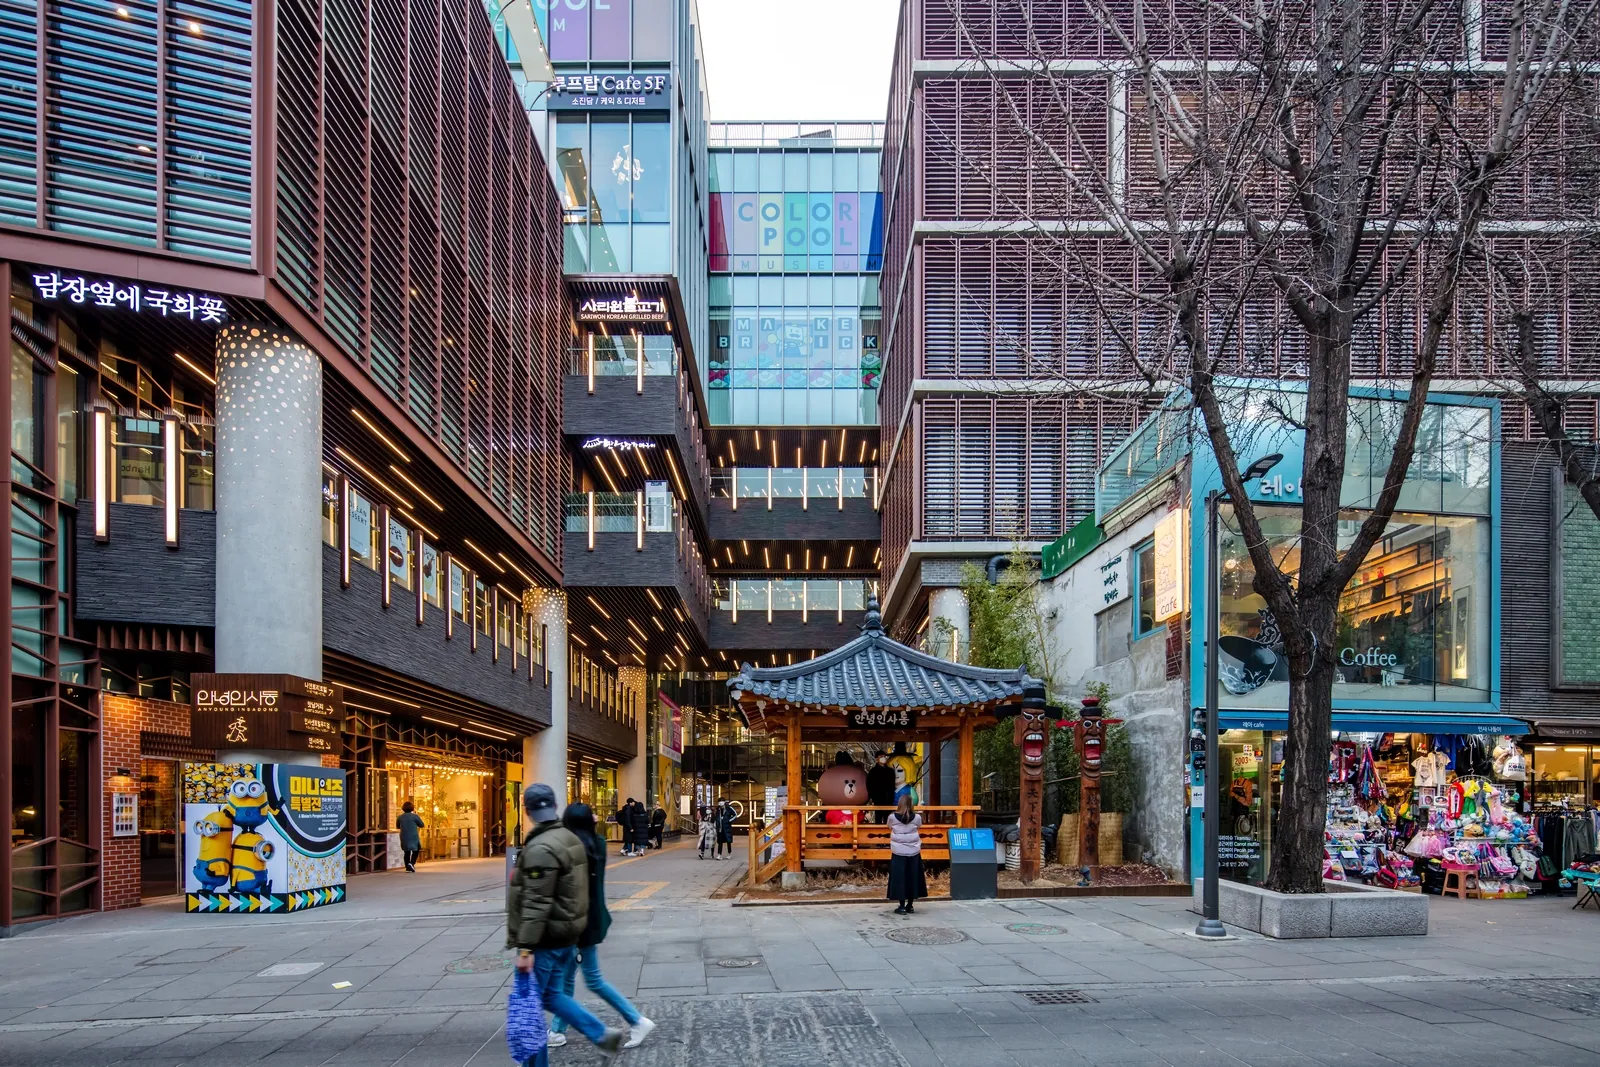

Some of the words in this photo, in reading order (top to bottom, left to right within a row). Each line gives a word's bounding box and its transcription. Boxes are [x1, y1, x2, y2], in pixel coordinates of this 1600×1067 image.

[602, 76, 641, 91] Cafe
[644, 76, 665, 90] 5F
[738, 202, 852, 222] COLOR
[764, 228, 852, 247] POOL
[741, 260, 877, 269] MUSEUM
[33, 273, 140, 312] 담장옆에
[143, 289, 227, 324] 국화꽃
[581, 296, 666, 313] 사리원불고기
[1340, 647, 1397, 666] Coffee
[1381, 669, 1396, 687] Tea
[197, 690, 279, 706] 안녕인사동
[854, 713, 910, 726] 안녕인사동
[290, 776, 343, 796] 미니언즈
[290, 796, 321, 812] 특별전
